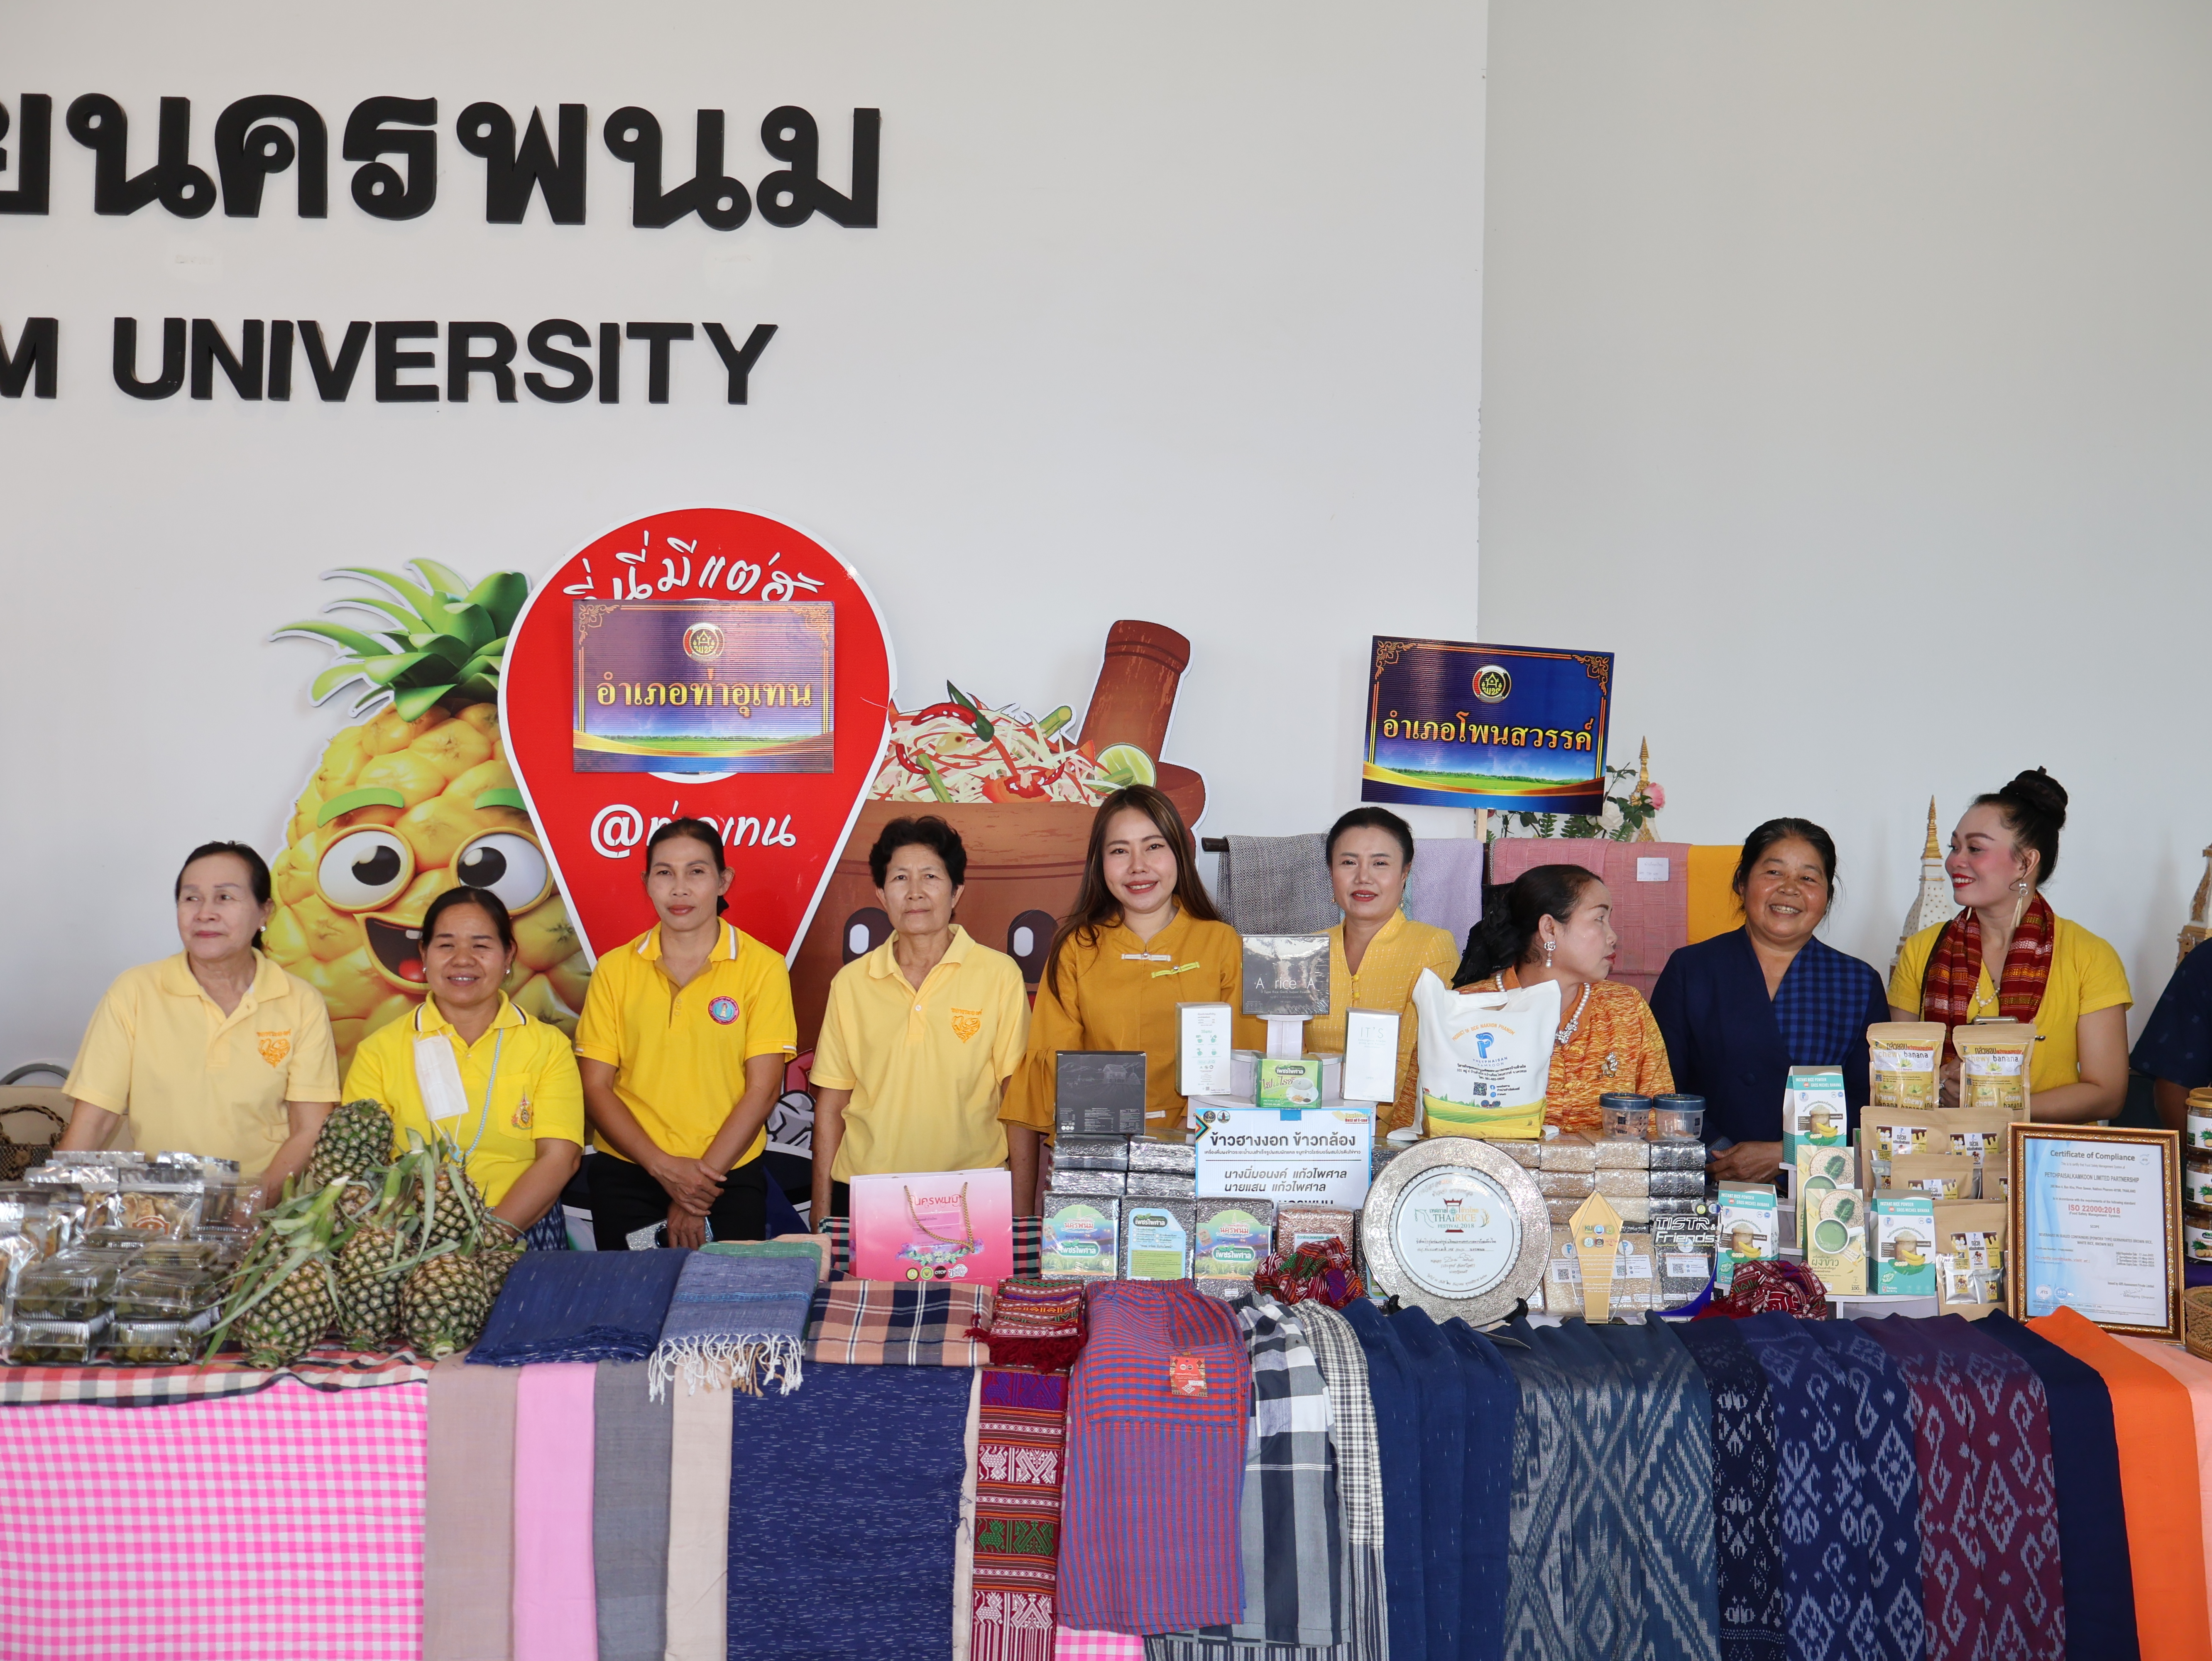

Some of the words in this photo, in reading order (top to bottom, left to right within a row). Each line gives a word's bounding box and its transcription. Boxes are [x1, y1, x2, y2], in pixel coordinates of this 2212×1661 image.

[113, 317, 778, 405] UNIVERSITY
[597, 668, 811, 717] อำเภอท่าอุเทน
[1383, 710, 1595, 751] อำเภอโพนสวรรค์
[1255, 977, 1264, 989] A
[1275, 977, 1297, 989] rice
[1307, 977, 1315, 989] A
[1452, 1030, 1465, 1041] PRODUCT
[1498, 1024, 1515, 1035] PHANOM
[1887, 1042, 1907, 1050] กล้วยอบ
[1904, 1097, 1923, 1107] chewy
[1211, 1132, 1289, 1146] ข้าวฮางงอก
[1293, 1132, 1356, 1146] ข้าวกล้อง
[2050, 1150, 2085, 1159] Certificate
[2095, 1152, 2135, 1161] Compliance
[1225, 1166, 1287, 1178] นางนิ่มอนงค์
[1293, 1167, 1347, 1178] แก้วไพศาล
[2044, 1172, 2093, 1180] PETCHPAISALKAMKOON
[1225, 1182, 1265, 1192] นายแสน
[1272, 1181, 1326, 1192] แก้วไพศาล
[910, 1194, 962, 1208] นครพนม
[2082, 1205, 2121, 1214] 22000:2018
[1656, 1217, 1710, 1230] TISTR
[1655, 1231, 1715, 1243] Friends
[1060, 1246, 1096, 1254] เพชรไพศาล
[1216, 1251, 1251, 1259] เพชรไพศาล
